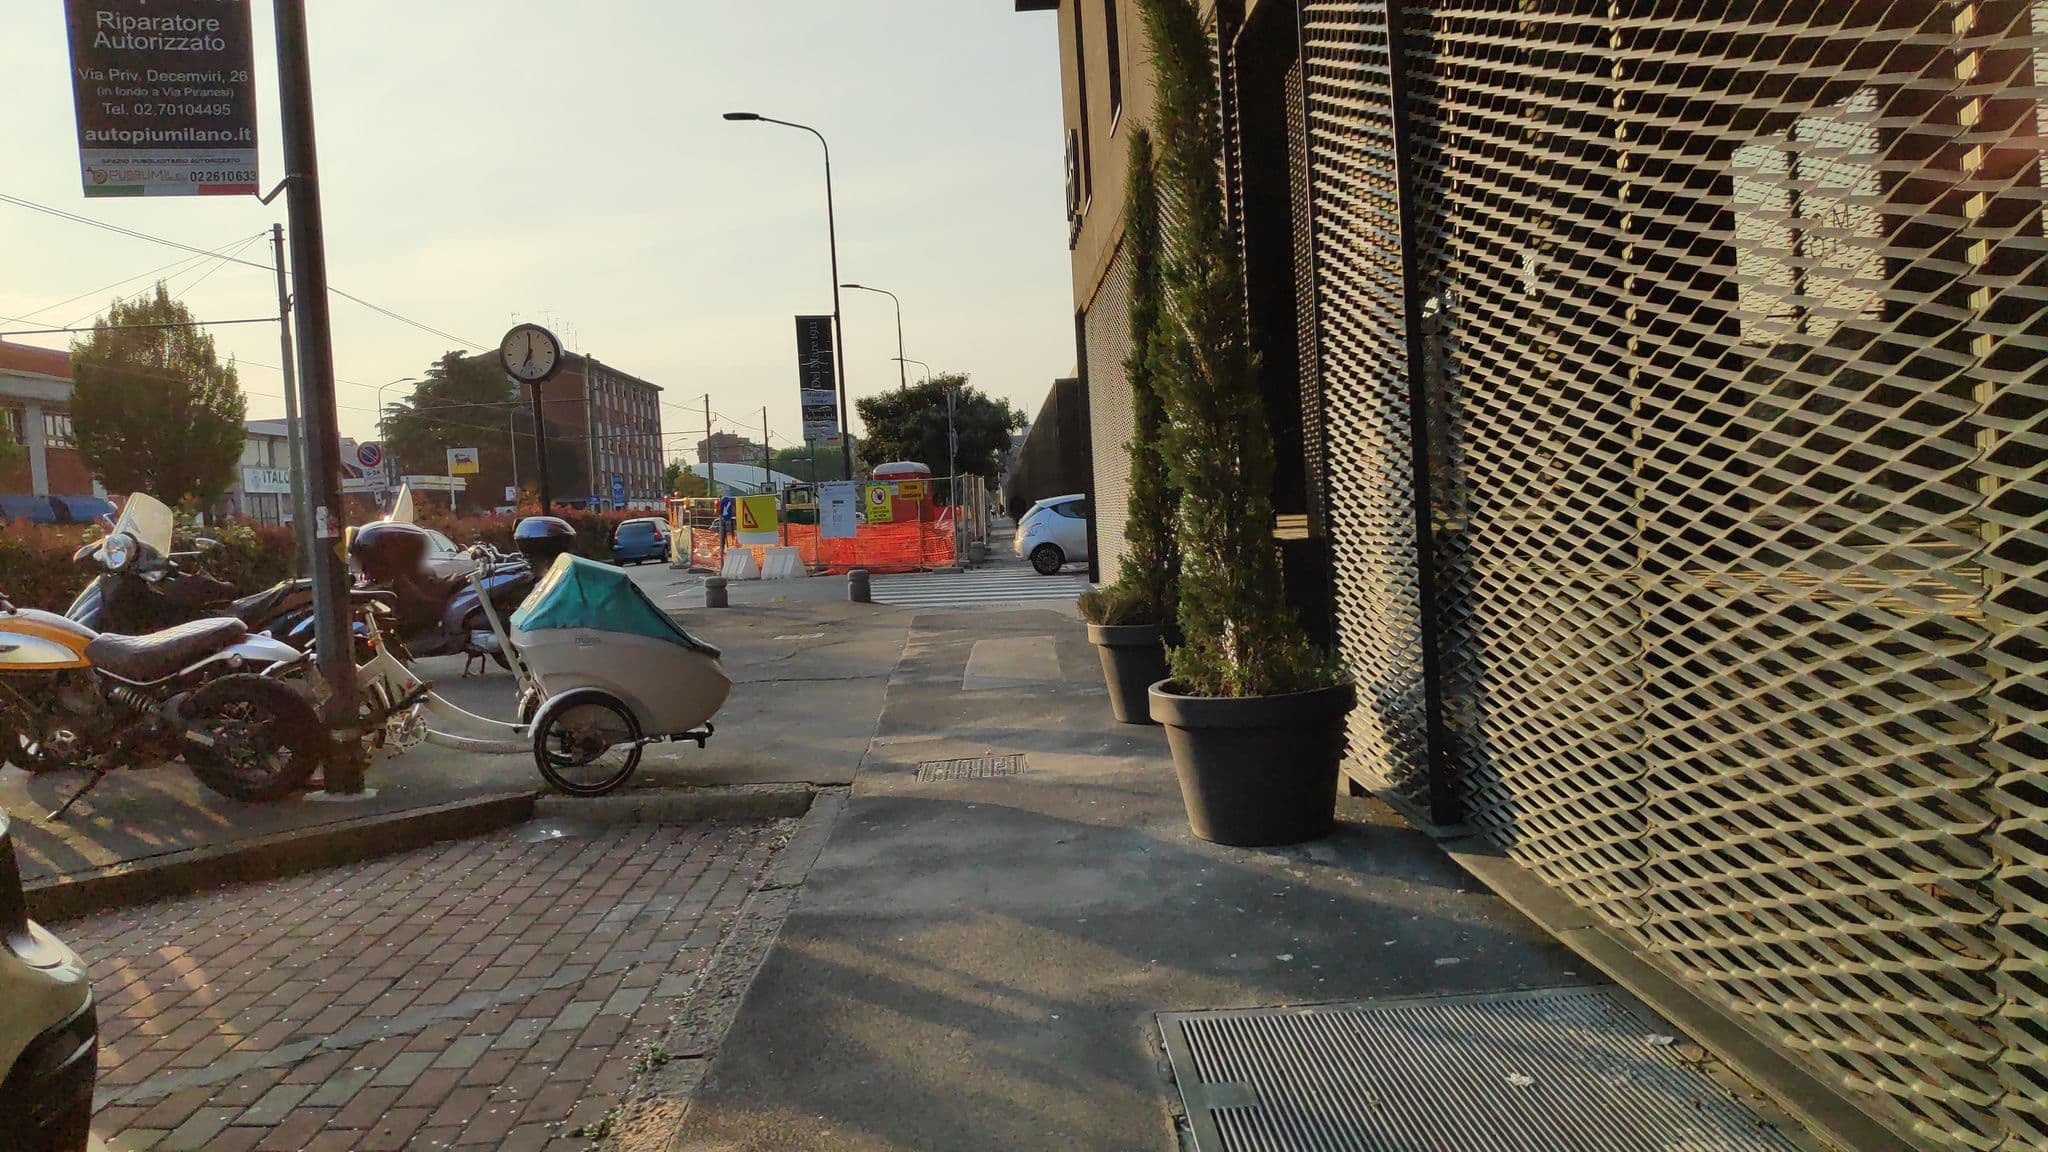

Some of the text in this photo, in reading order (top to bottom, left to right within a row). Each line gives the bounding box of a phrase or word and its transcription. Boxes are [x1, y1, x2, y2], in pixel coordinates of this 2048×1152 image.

[96, 11, 220, 33] Riparatore
[93, 31, 225, 51] Autorizzato
[79, 68, 248, 84] Via Priv. Decemviri, 26
[163, 87, 181, 97] Via
[103, 102, 231, 116] Tel. 02.70104495
[85, 127, 252, 145] autopiumilano.it
[190, 171, 257, 182] 022610633
